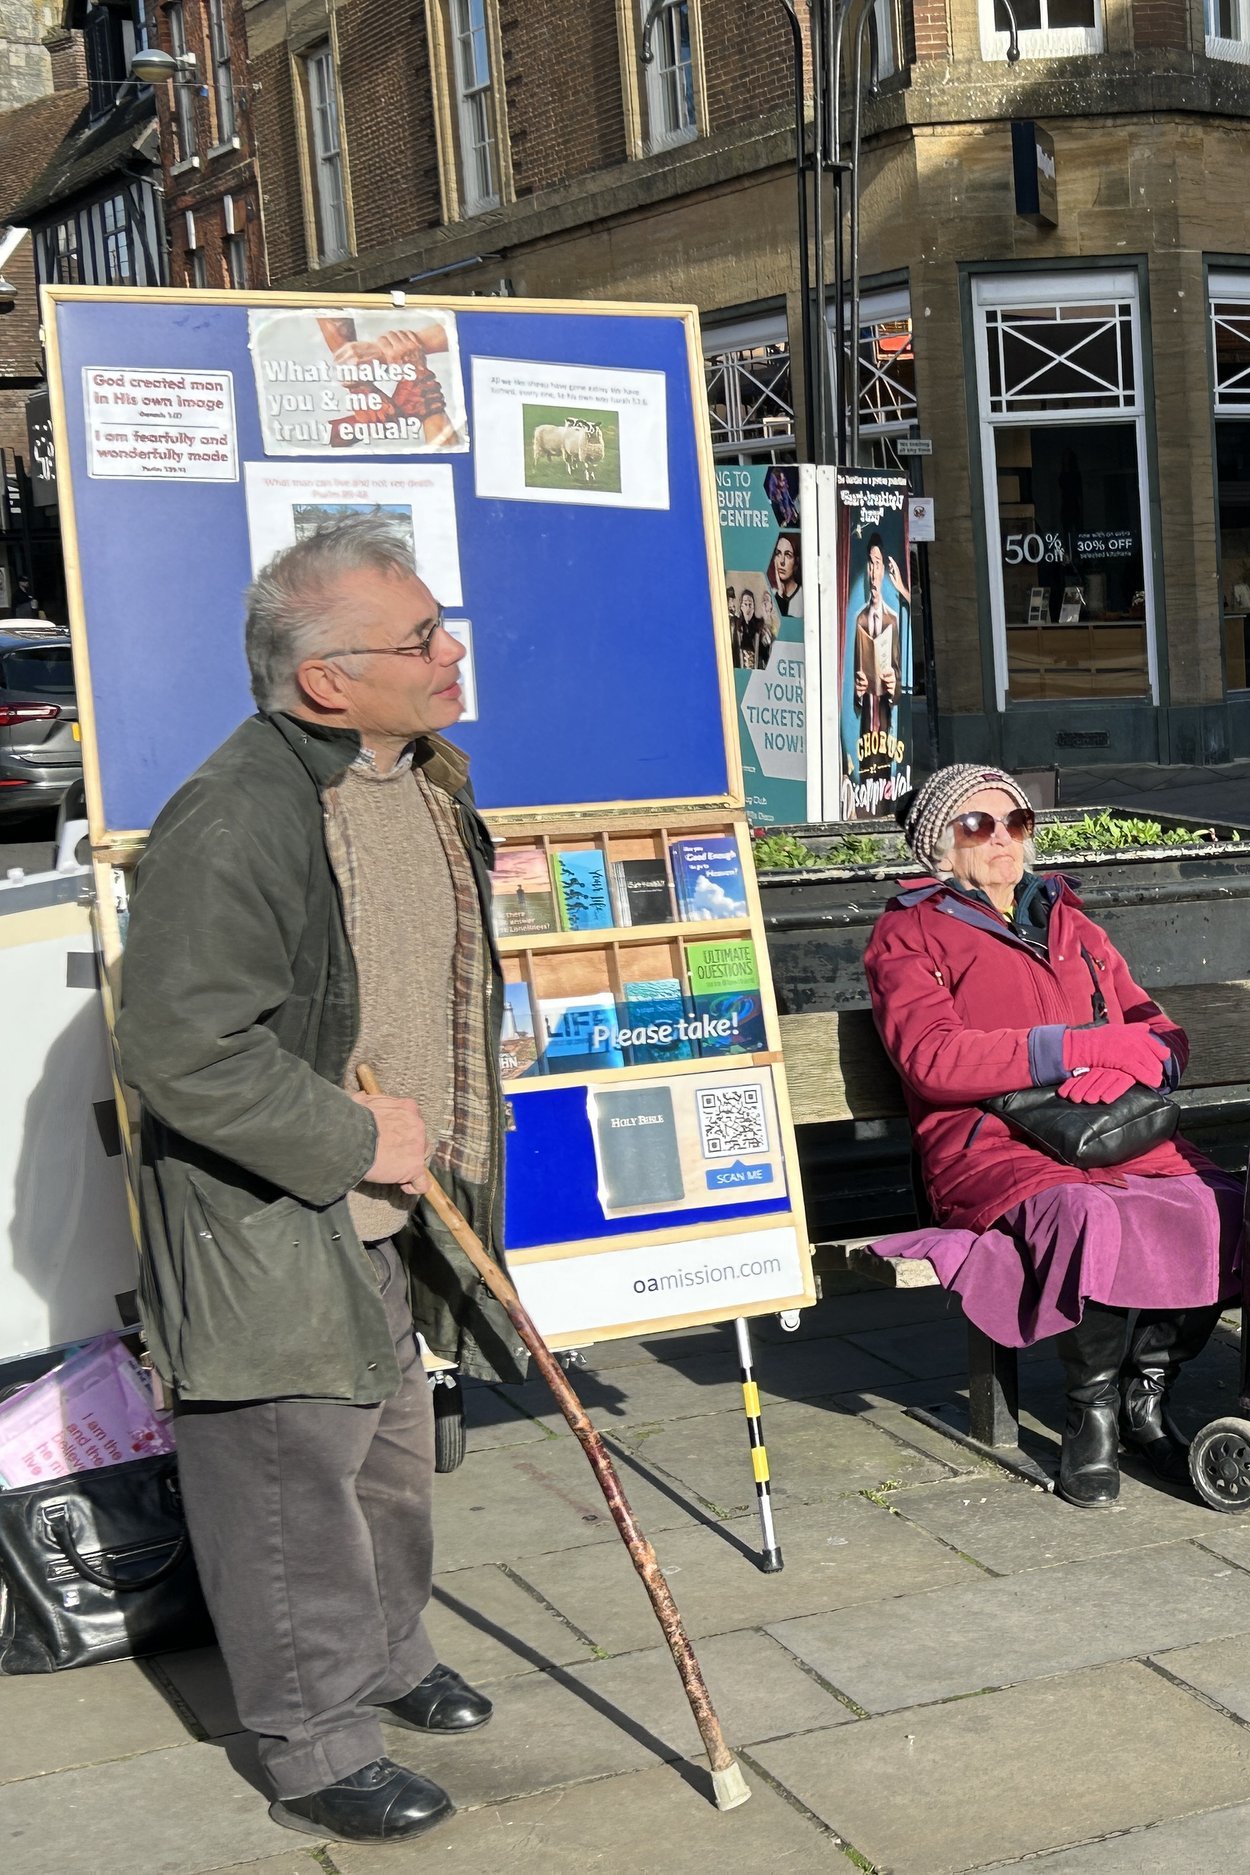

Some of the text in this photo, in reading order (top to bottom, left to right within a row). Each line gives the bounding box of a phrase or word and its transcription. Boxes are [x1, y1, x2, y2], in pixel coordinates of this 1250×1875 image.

[264, 360, 417, 382] What makes
[93, 374, 224, 392] God created man
[94, 392, 224, 411] in His own image
[268, 390, 382, 416] you & me
[95, 431, 228, 447] I am fearfully and
[274, 417, 422, 445] truly equal?
[97, 448, 228, 463] wonderfully made
[734, 472, 750, 486] TO
[718, 491, 751, 508] BURY
[720, 510, 769, 528] CENTRE
[1077, 539, 1132, 551] 30% OFF
[778, 658, 804, 678] GET
[764, 682, 804, 704] YOUR
[747, 706, 804, 728] TICKETS
[764, 732, 804, 754] NOW!
[857, 730, 904, 763] CHORUS
[703, 947, 751, 964] ULTIMATE
[698, 961, 753, 979] QUESTIONS
[593, 1012, 740, 1050] Please take!
[611, 1114, 664, 1128] HOLY BIBLE
[716, 1170, 763, 1184] SCAN ME
[633, 1257, 782, 1294] oamission.com
[67, 1423, 104, 1466] and the
[88, 1421, 106, 1440] am
[104, 1439, 122, 1460] the
[21, 1452, 42, 1476] live
